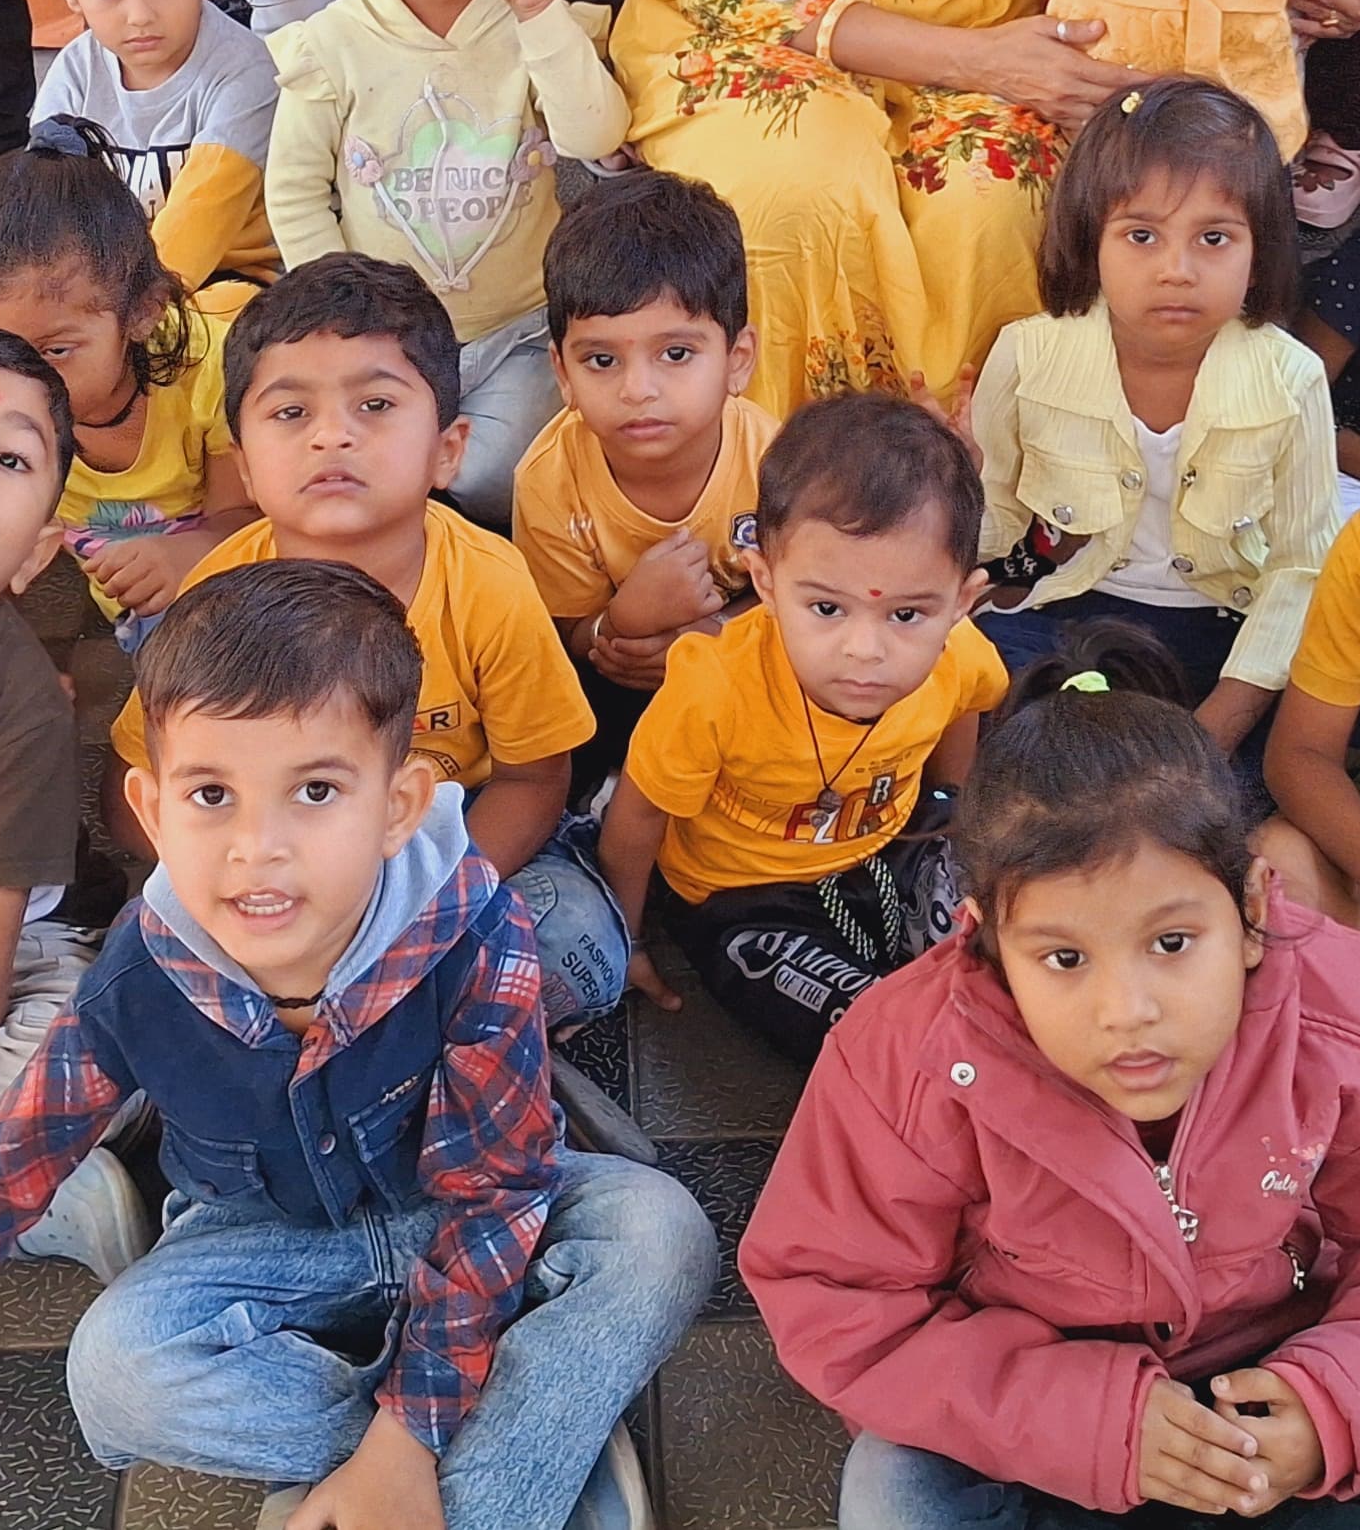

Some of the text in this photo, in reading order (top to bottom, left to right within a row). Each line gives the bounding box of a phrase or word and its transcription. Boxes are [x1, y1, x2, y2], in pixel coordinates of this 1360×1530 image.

[445, 167, 511, 192] NIC
[561, 951, 601, 1004] SUPER
[578, 933, 617, 988] FASHION
[776, 968, 827, 1009] OF THE
